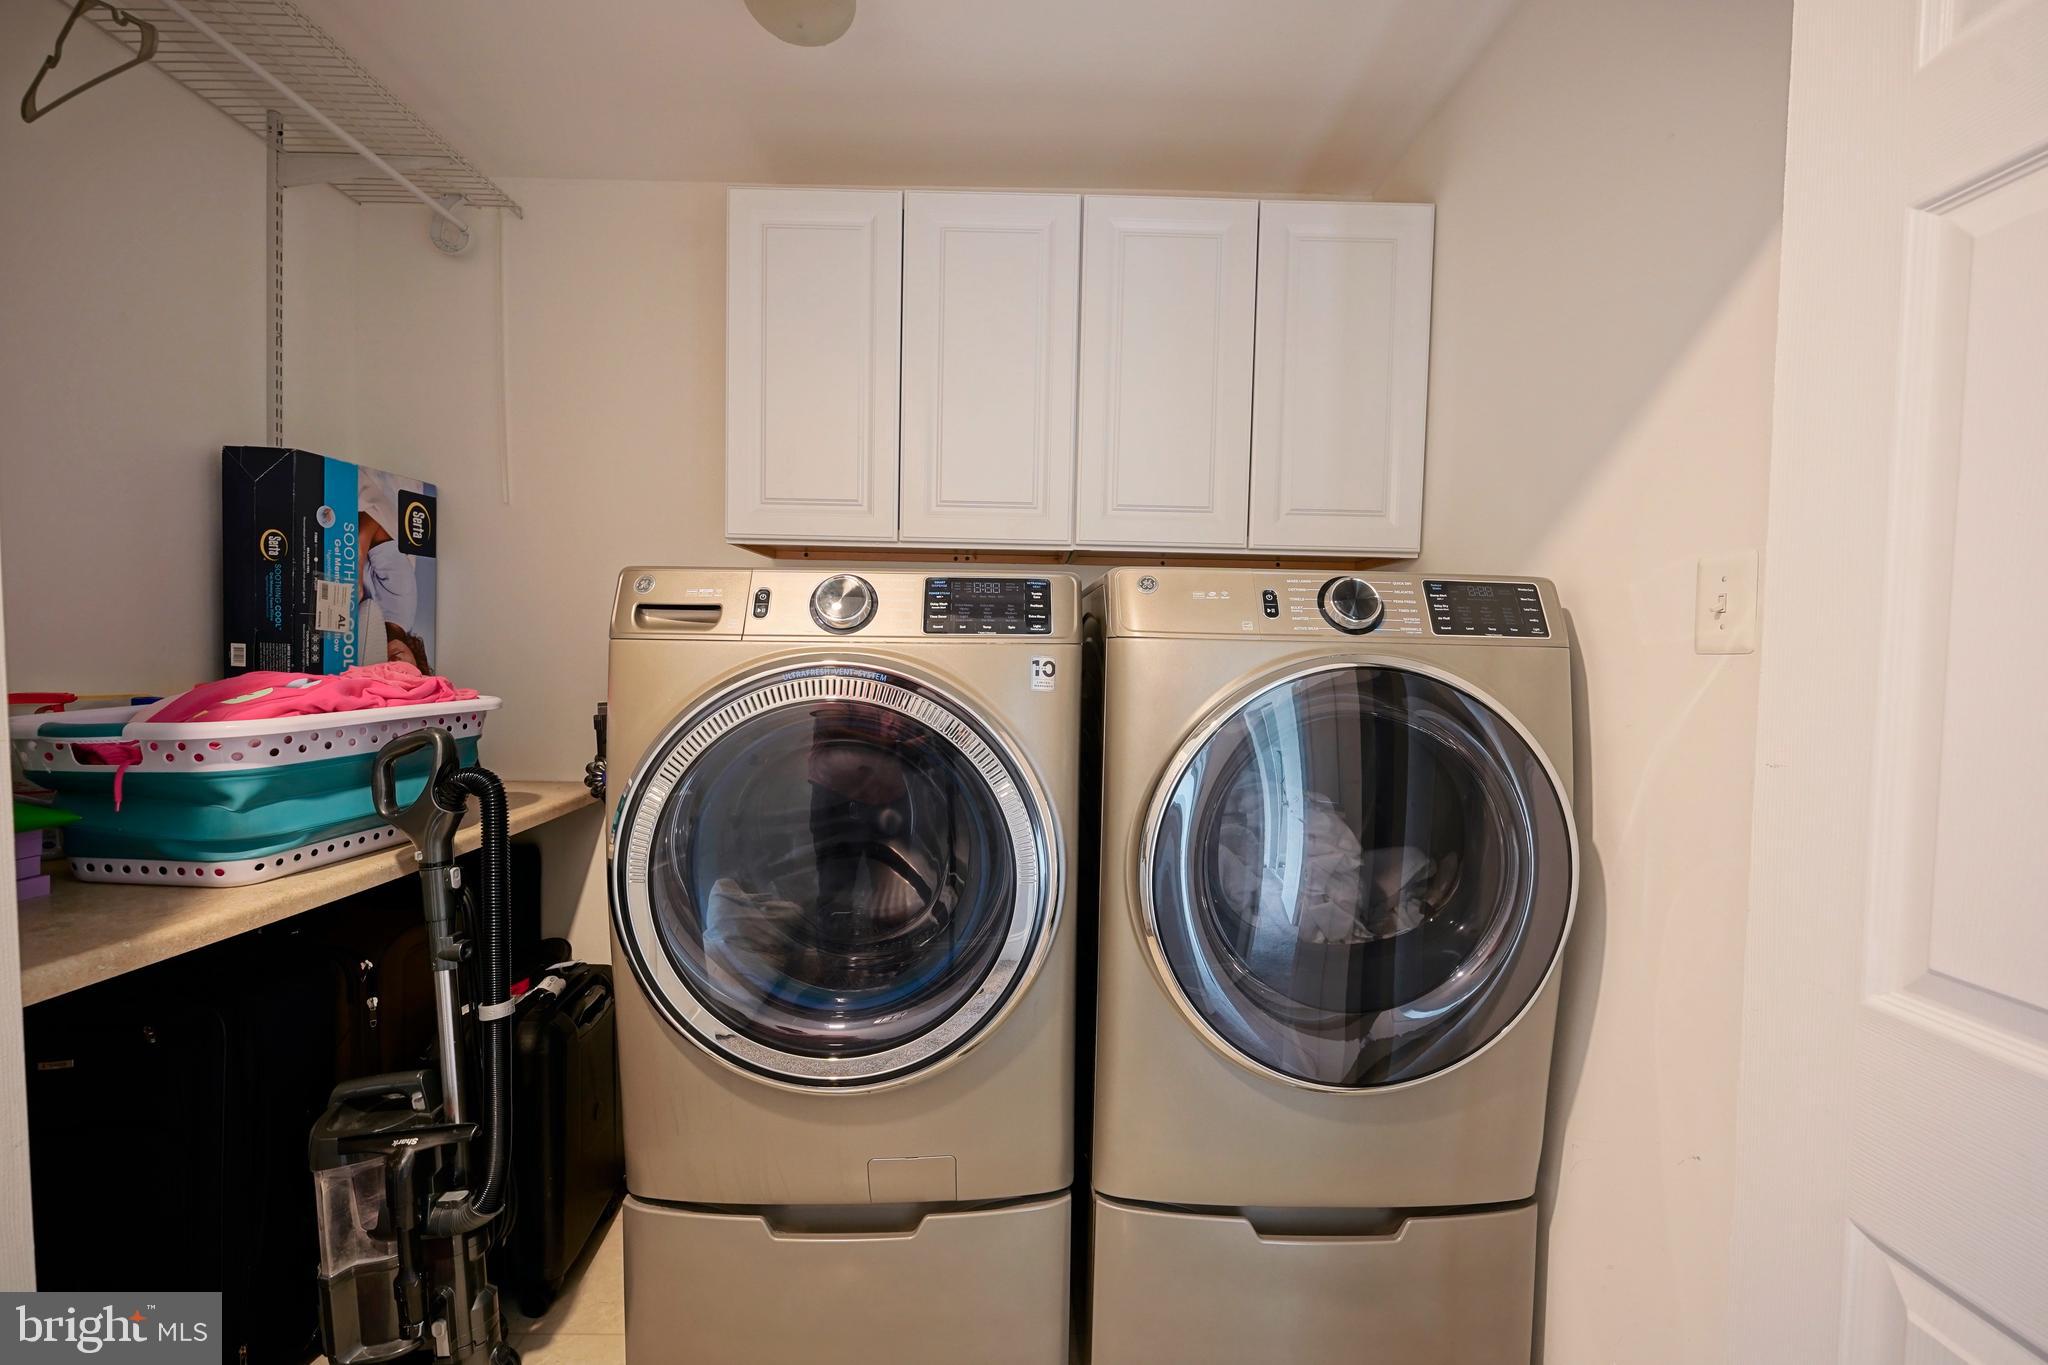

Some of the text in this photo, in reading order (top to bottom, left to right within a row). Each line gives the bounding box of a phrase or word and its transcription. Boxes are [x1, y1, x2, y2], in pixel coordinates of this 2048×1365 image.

[412, 511, 425, 539] Serta
[268, 536, 282, 556] Serta
[274, 564, 282, 604] SOOTHING
[338, 614, 347, 630] AL
[835, 668, 852, 676] VENT
[391, 1137, 419, 1147] Shark
